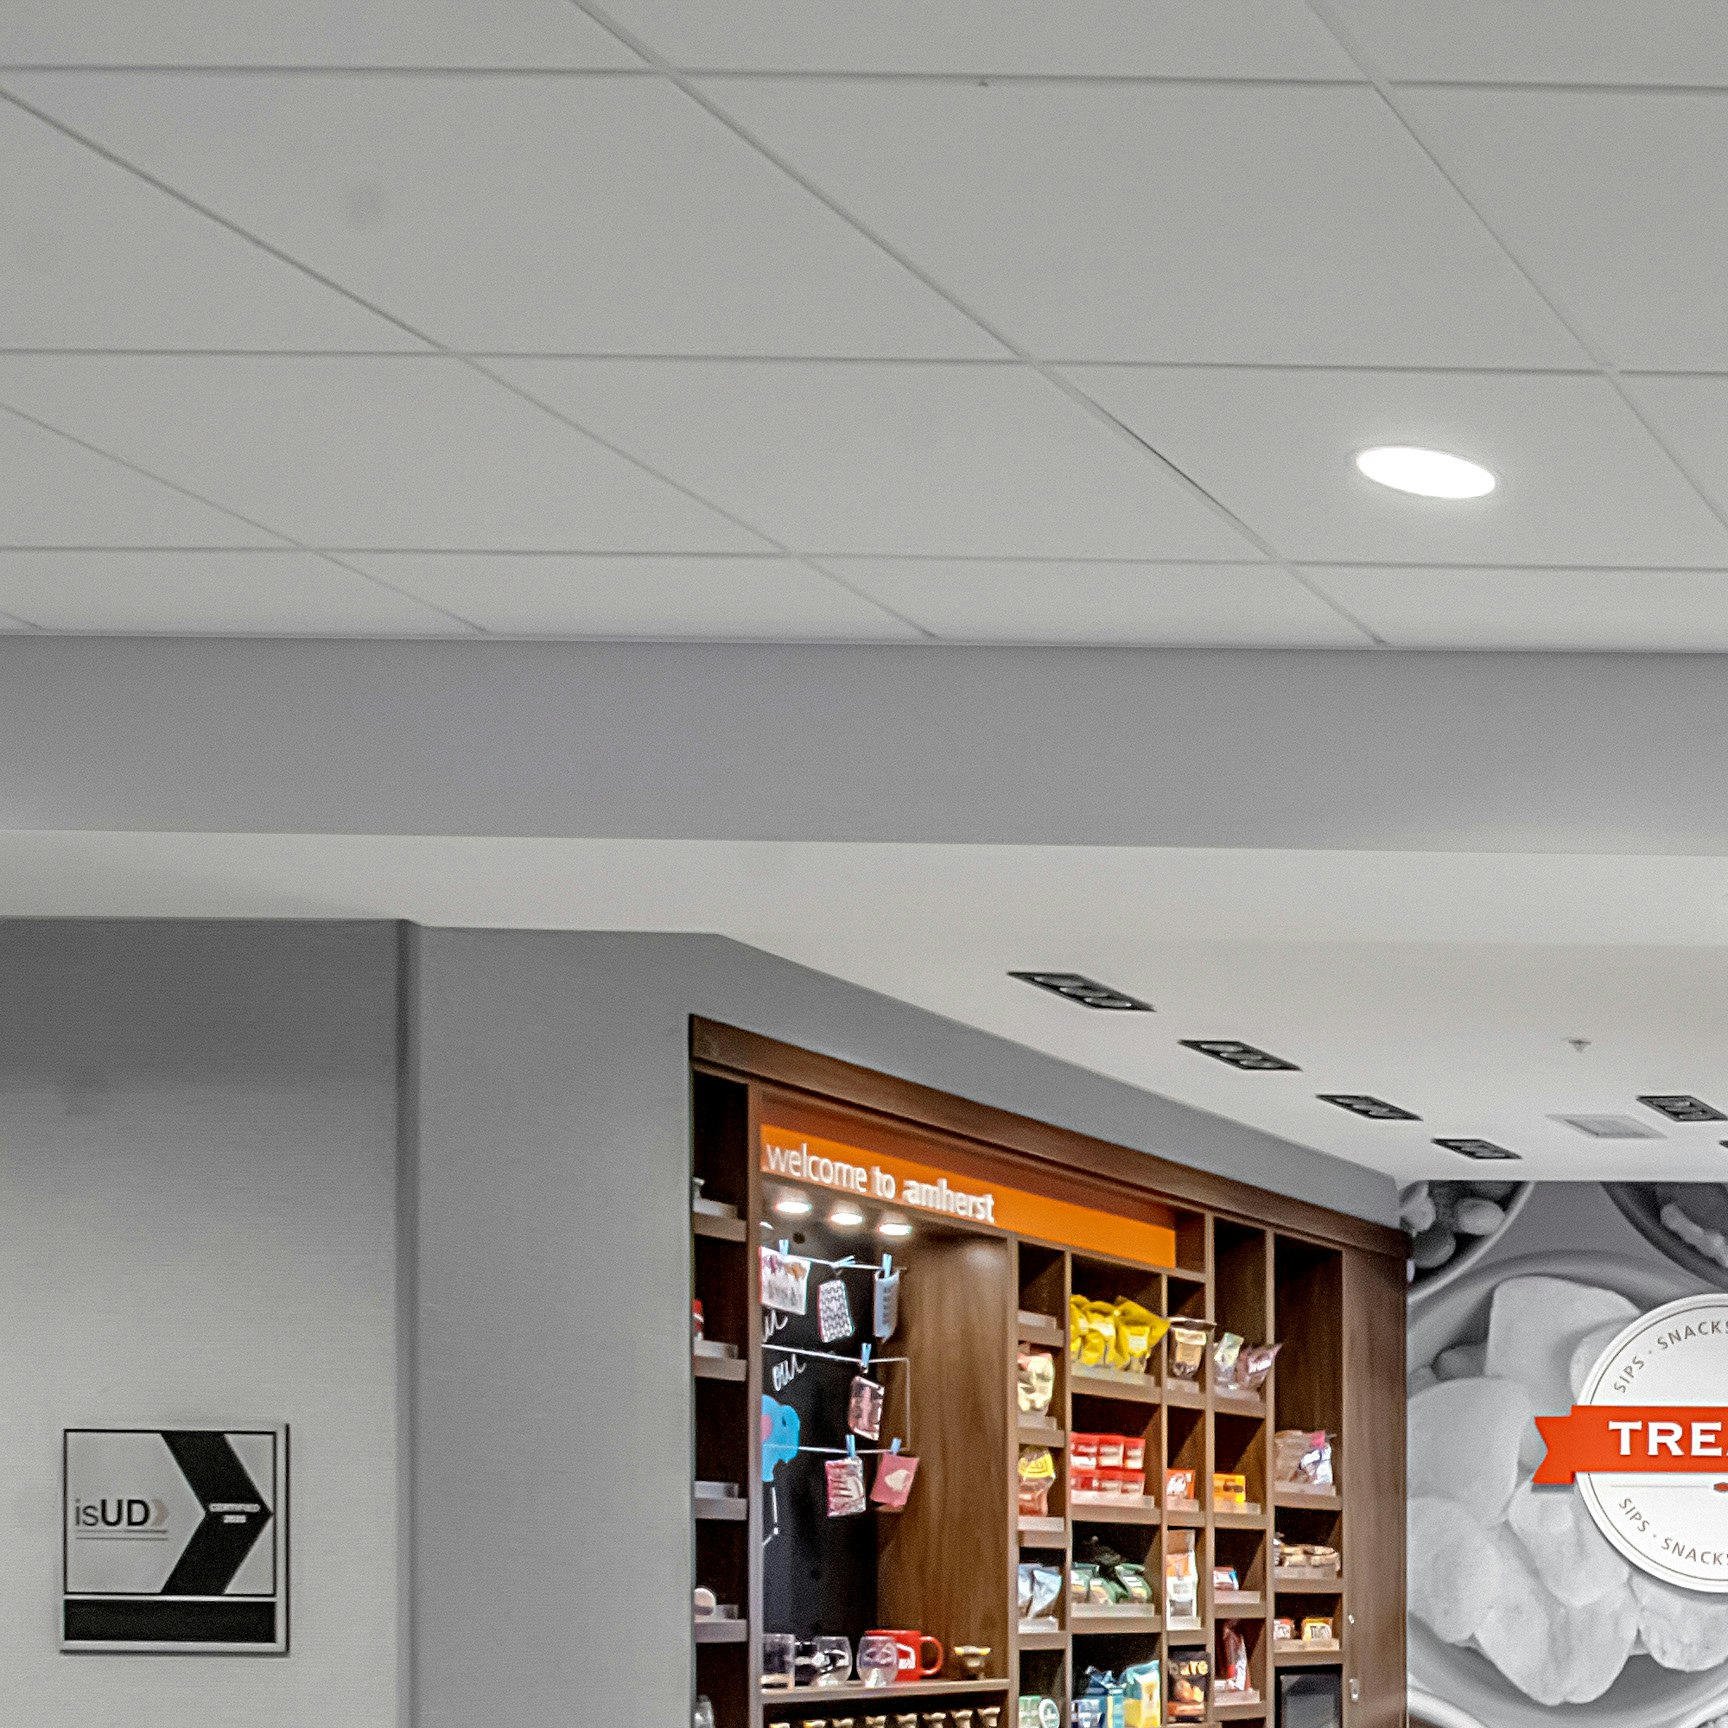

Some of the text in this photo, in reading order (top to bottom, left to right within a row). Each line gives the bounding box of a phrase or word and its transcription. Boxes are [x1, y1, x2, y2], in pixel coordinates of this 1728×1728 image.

[765, 1143, 995, 1224] welcome to amherst
[1614, 1355, 1645, 1394] SIPS
[75, 1499, 151, 1527] isUD
[1618, 1498, 1650, 1533] SIPS
